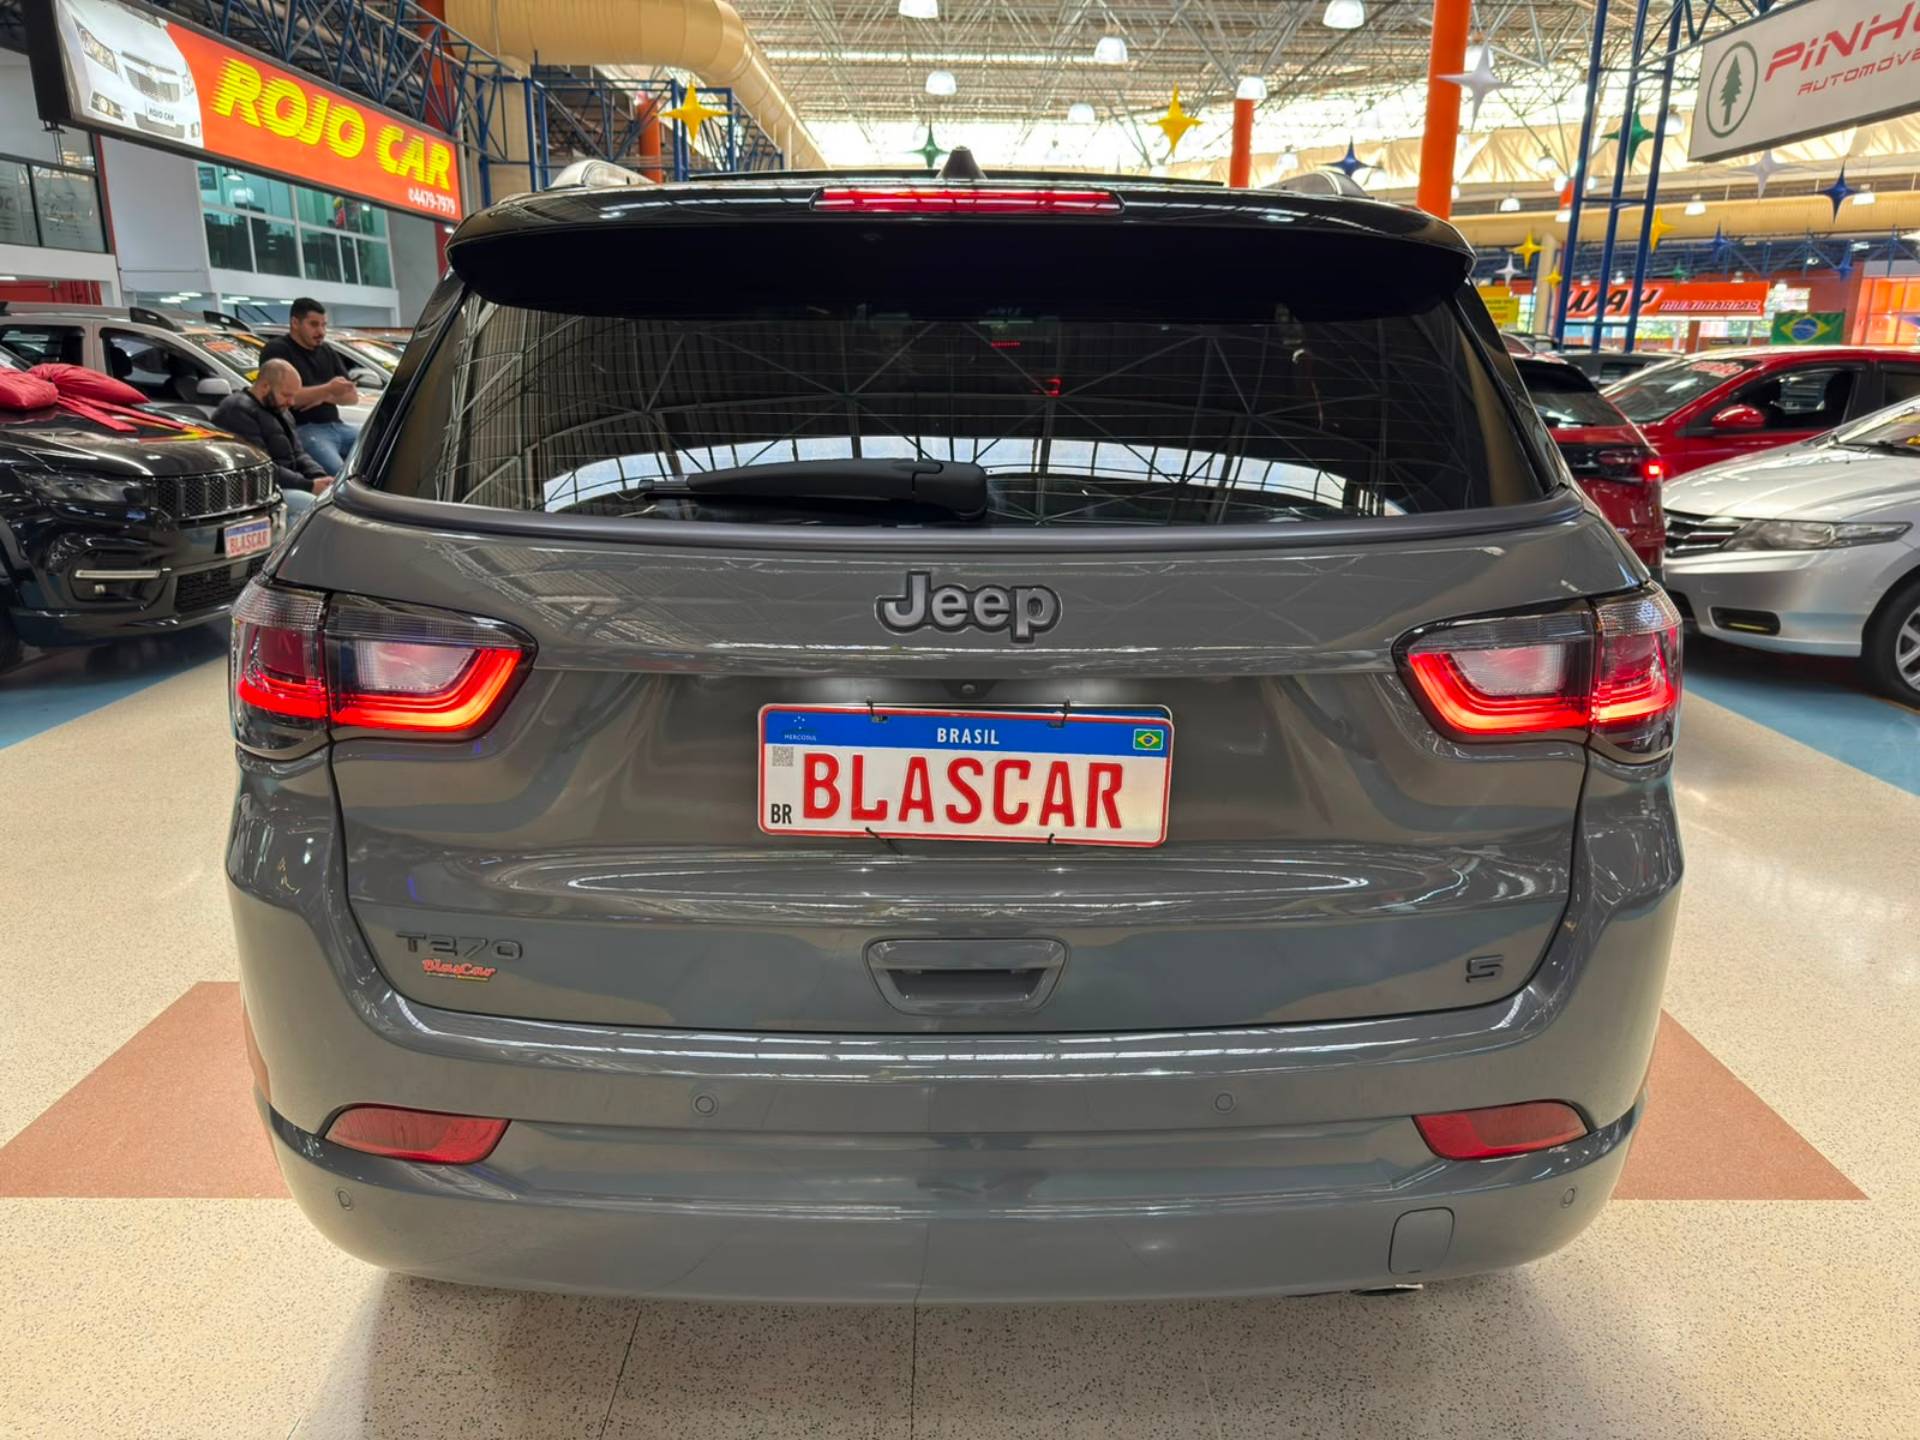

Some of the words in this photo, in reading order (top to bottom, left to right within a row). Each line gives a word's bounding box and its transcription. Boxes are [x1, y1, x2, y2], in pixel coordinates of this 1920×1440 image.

[210, 56, 366, 159] ROJO
[376, 124, 451, 192] CAR
[229, 530, 269, 554] BLASCAR
[875, 570, 1061, 643] Jeep
[936, 727, 1000, 746] BRASIL
[803, 752, 1123, 829] BLASCAR
[770, 803, 793, 825] BR
[395, 931, 524, 961] T270
[1465, 954, 1504, 984] S
